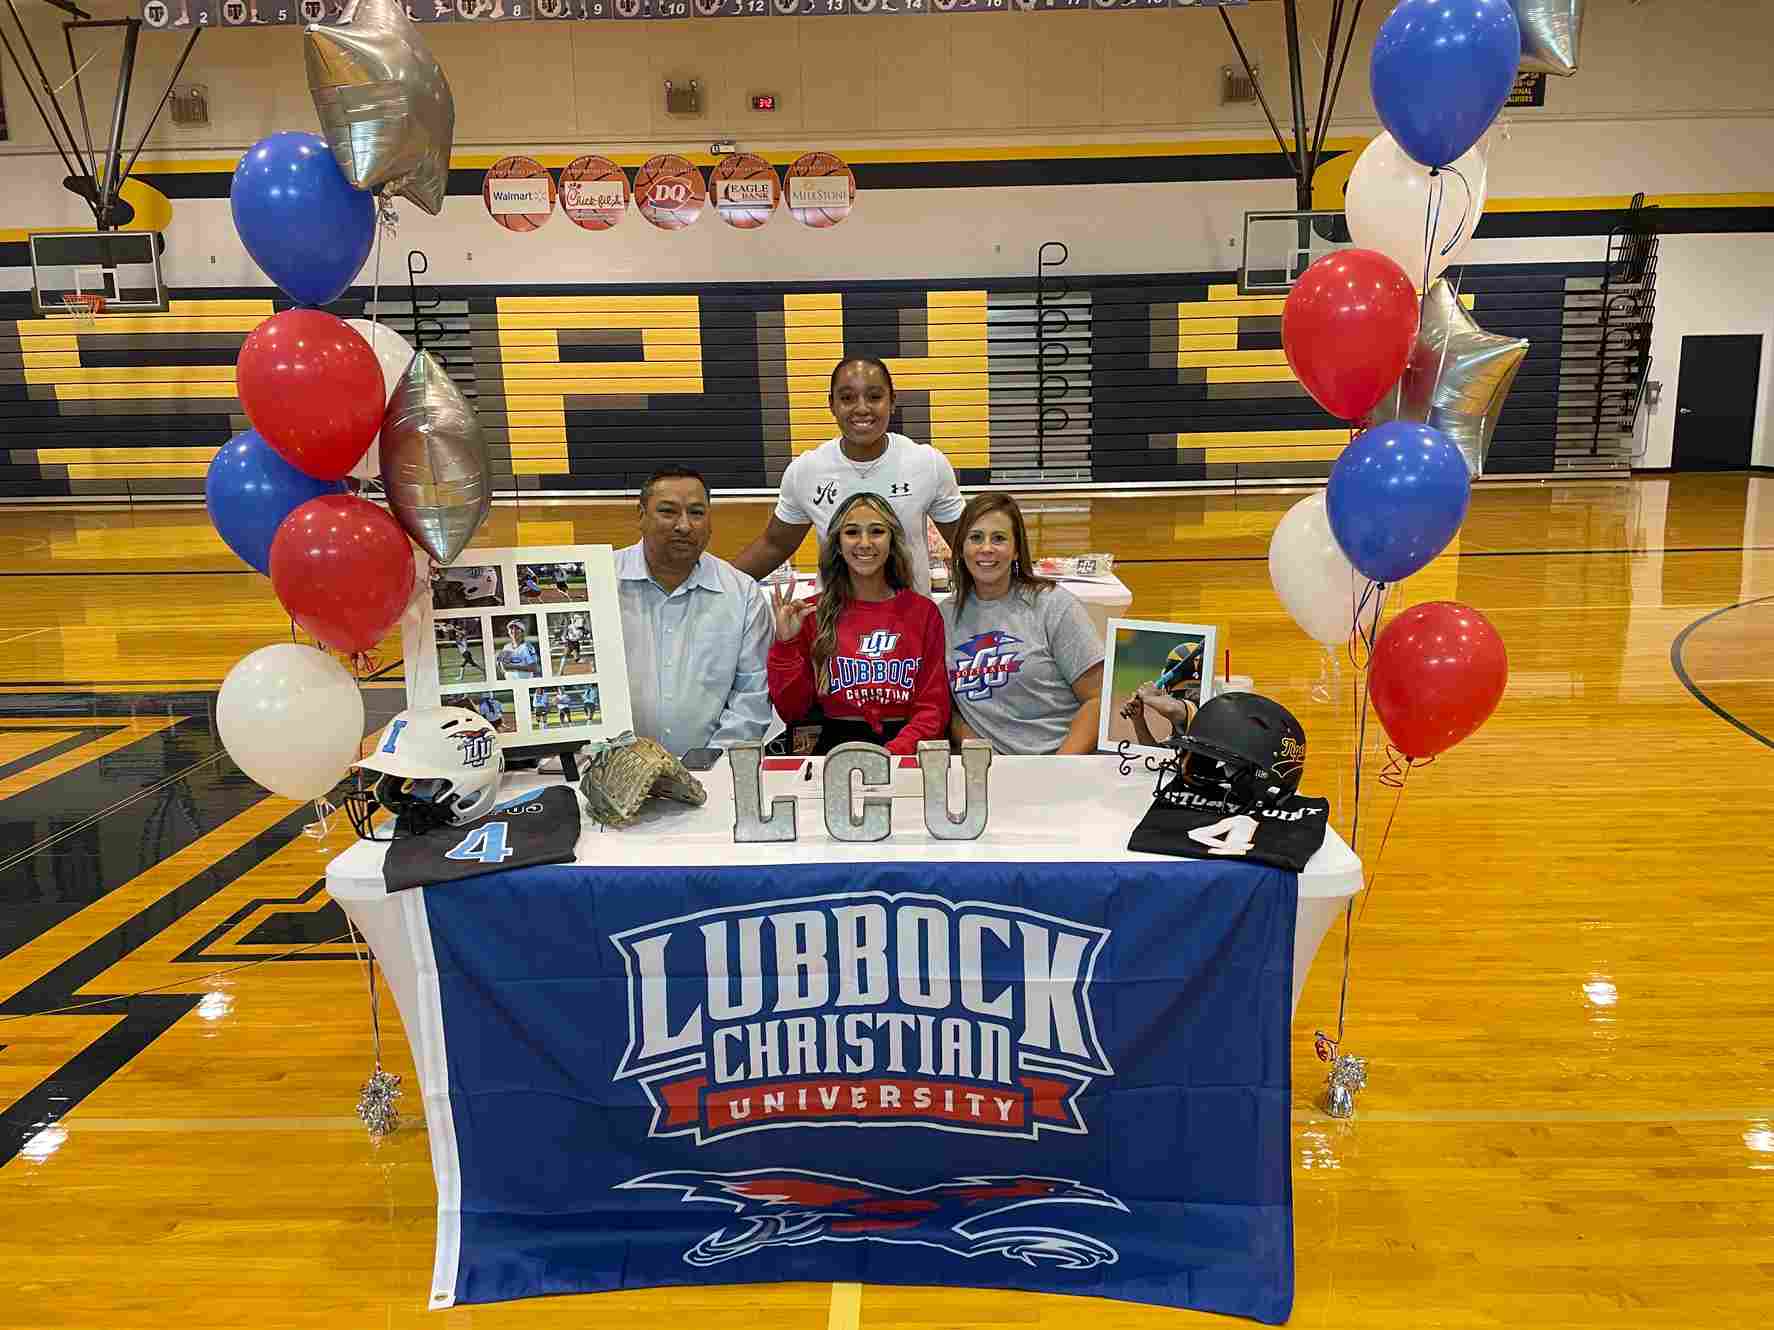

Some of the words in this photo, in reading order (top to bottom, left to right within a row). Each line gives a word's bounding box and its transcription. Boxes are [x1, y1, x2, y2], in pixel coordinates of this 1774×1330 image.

[513, 5, 521, 17] 8
[594, 4, 603, 15] 9
[668, 3, 685, 15] 10
[749, 0, 765, 12] 12
[199, 11, 208, 24] 2
[279, 9, 288, 21] 5
[655, 184, 688, 201] DQ
[731, 183, 769, 194] EAGLE
[493, 190, 533, 201] Walmart
[742, 192, 769, 201] BANK
[829, 656, 923, 694] LUBBOC
[846, 688, 911, 702] CHRISTIAN
[728, 740, 992, 843] LCU
[1186, 814, 1260, 856] 4
[444, 821, 514, 864] 4
[631, 902, 1092, 1061] LUBBOCK
[713, 1013, 1014, 1086] CHRISTIAN
[728, 1085, 1018, 1122] UNIVERSITY
